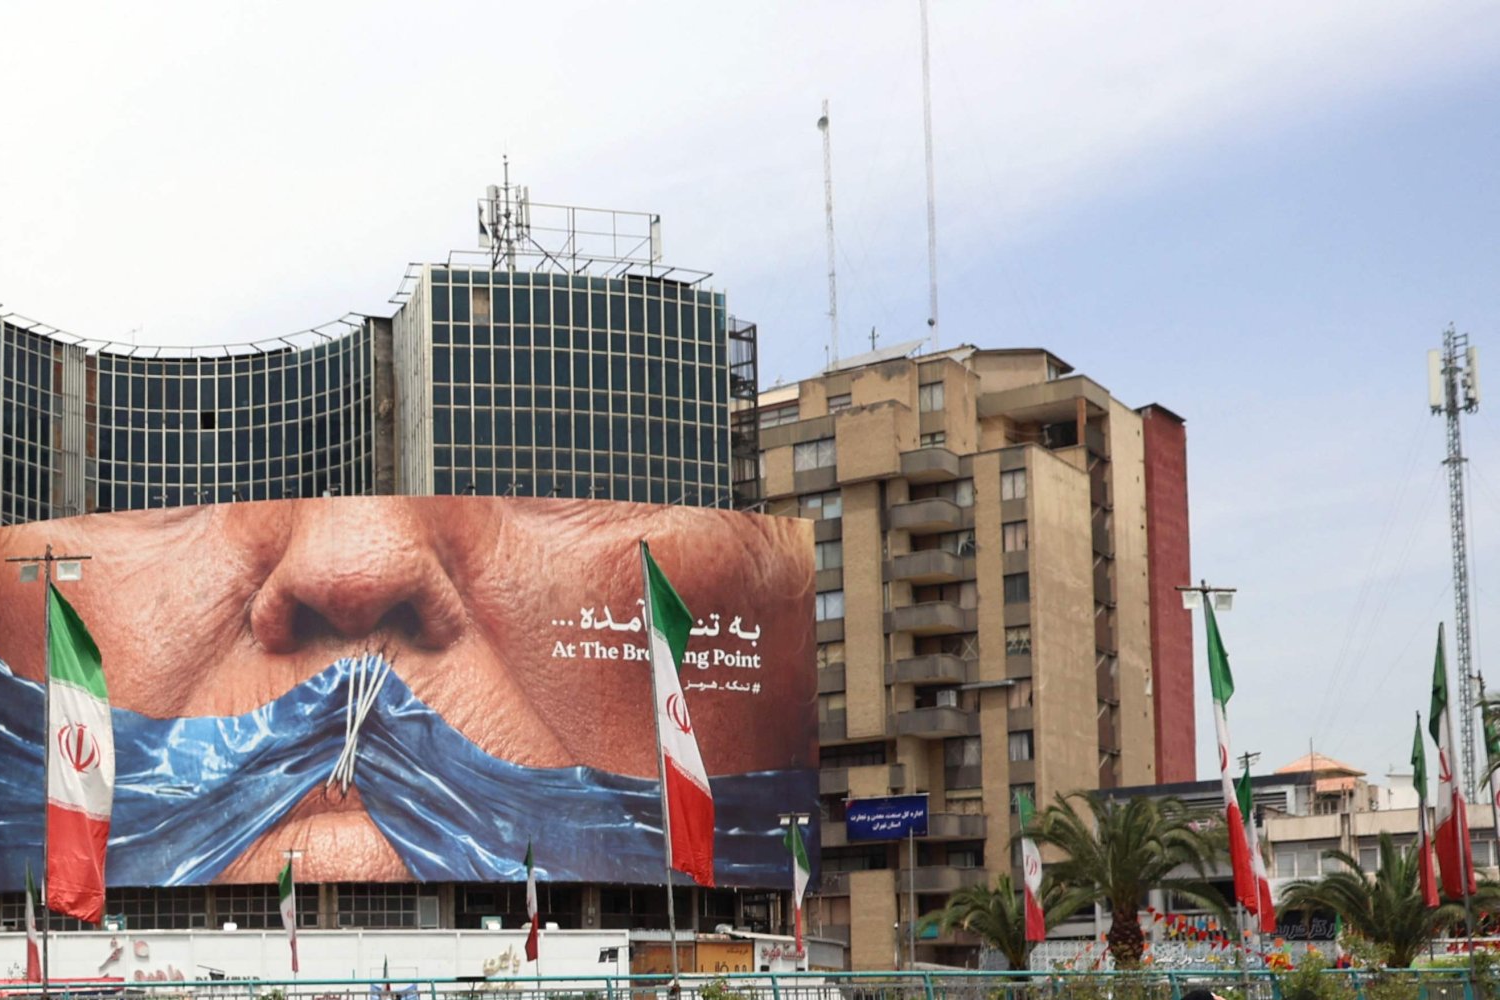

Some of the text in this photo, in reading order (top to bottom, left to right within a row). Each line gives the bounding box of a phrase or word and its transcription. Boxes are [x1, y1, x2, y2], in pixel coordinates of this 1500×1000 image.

[688, 612, 720, 637] تن
[728, 615, 761, 648] به
[551, 640, 577, 659] At
[579, 640, 620, 660] The
[713, 648, 762, 669] Point
